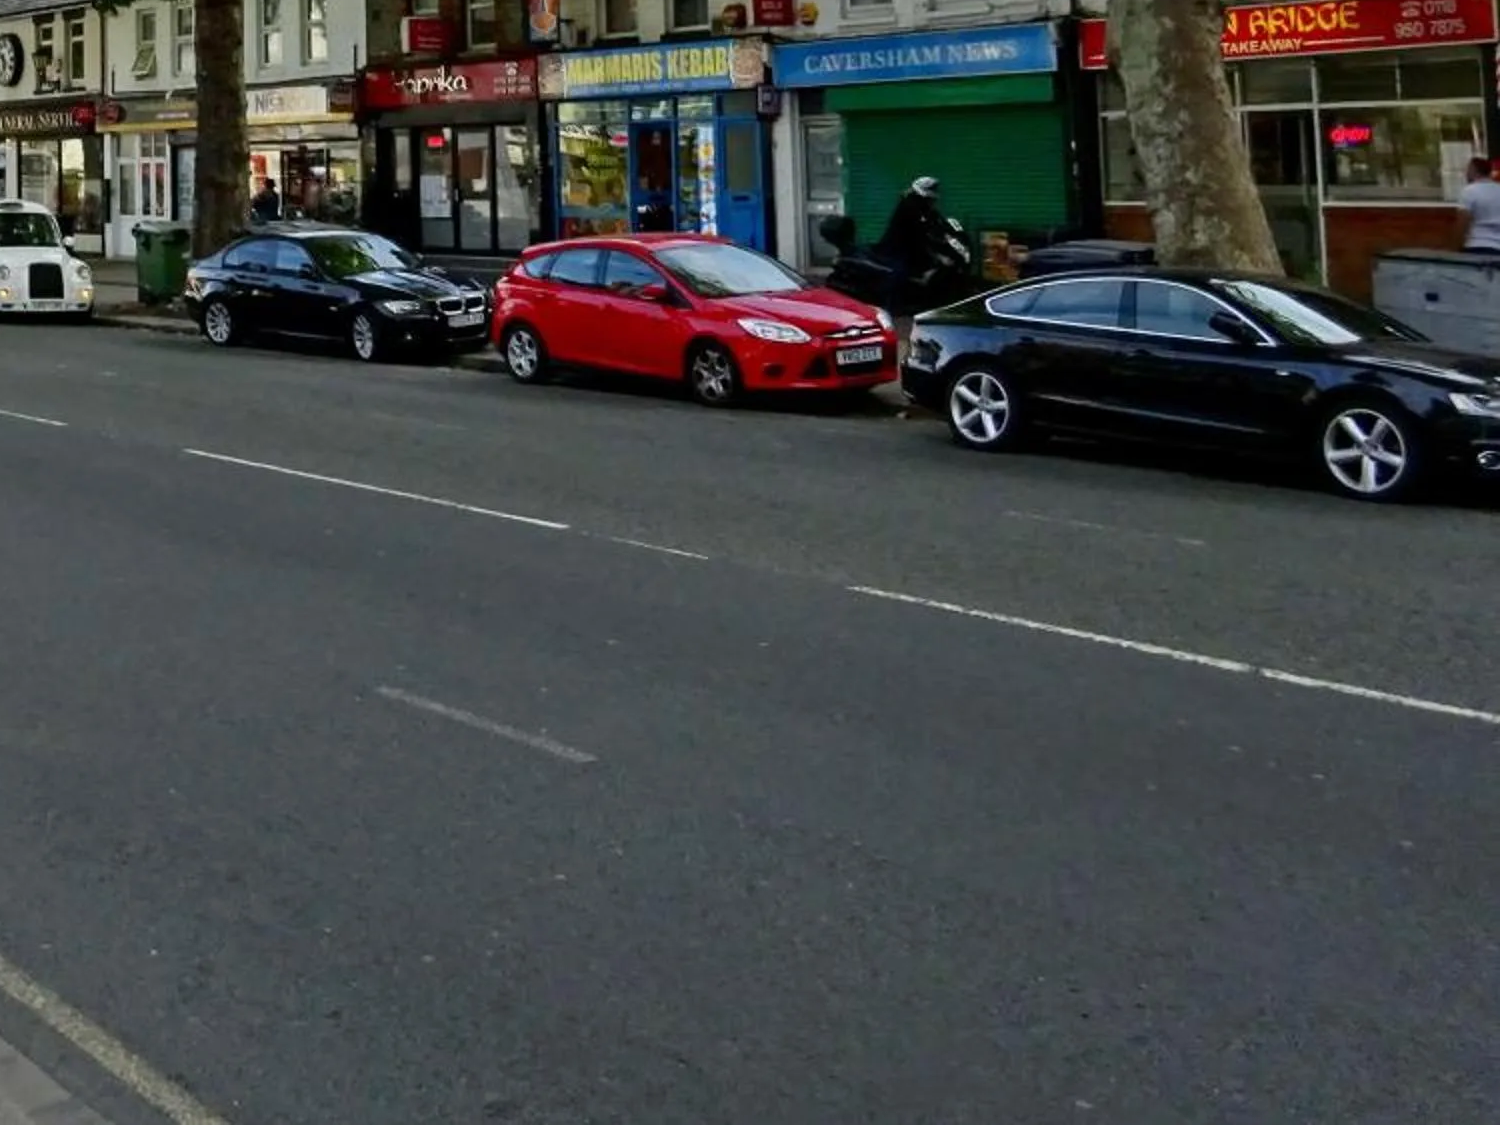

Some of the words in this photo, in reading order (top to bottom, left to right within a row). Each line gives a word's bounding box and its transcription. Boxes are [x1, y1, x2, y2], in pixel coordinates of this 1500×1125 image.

[803, 44, 942, 74] CAVERSHAM
[949, 39, 1018, 64] NEWS
[1220, 39, 1303, 55] TAKEAWAY
[567, 51, 662, 86] MARMARIS
[666, 46, 728, 80] KEBAB
